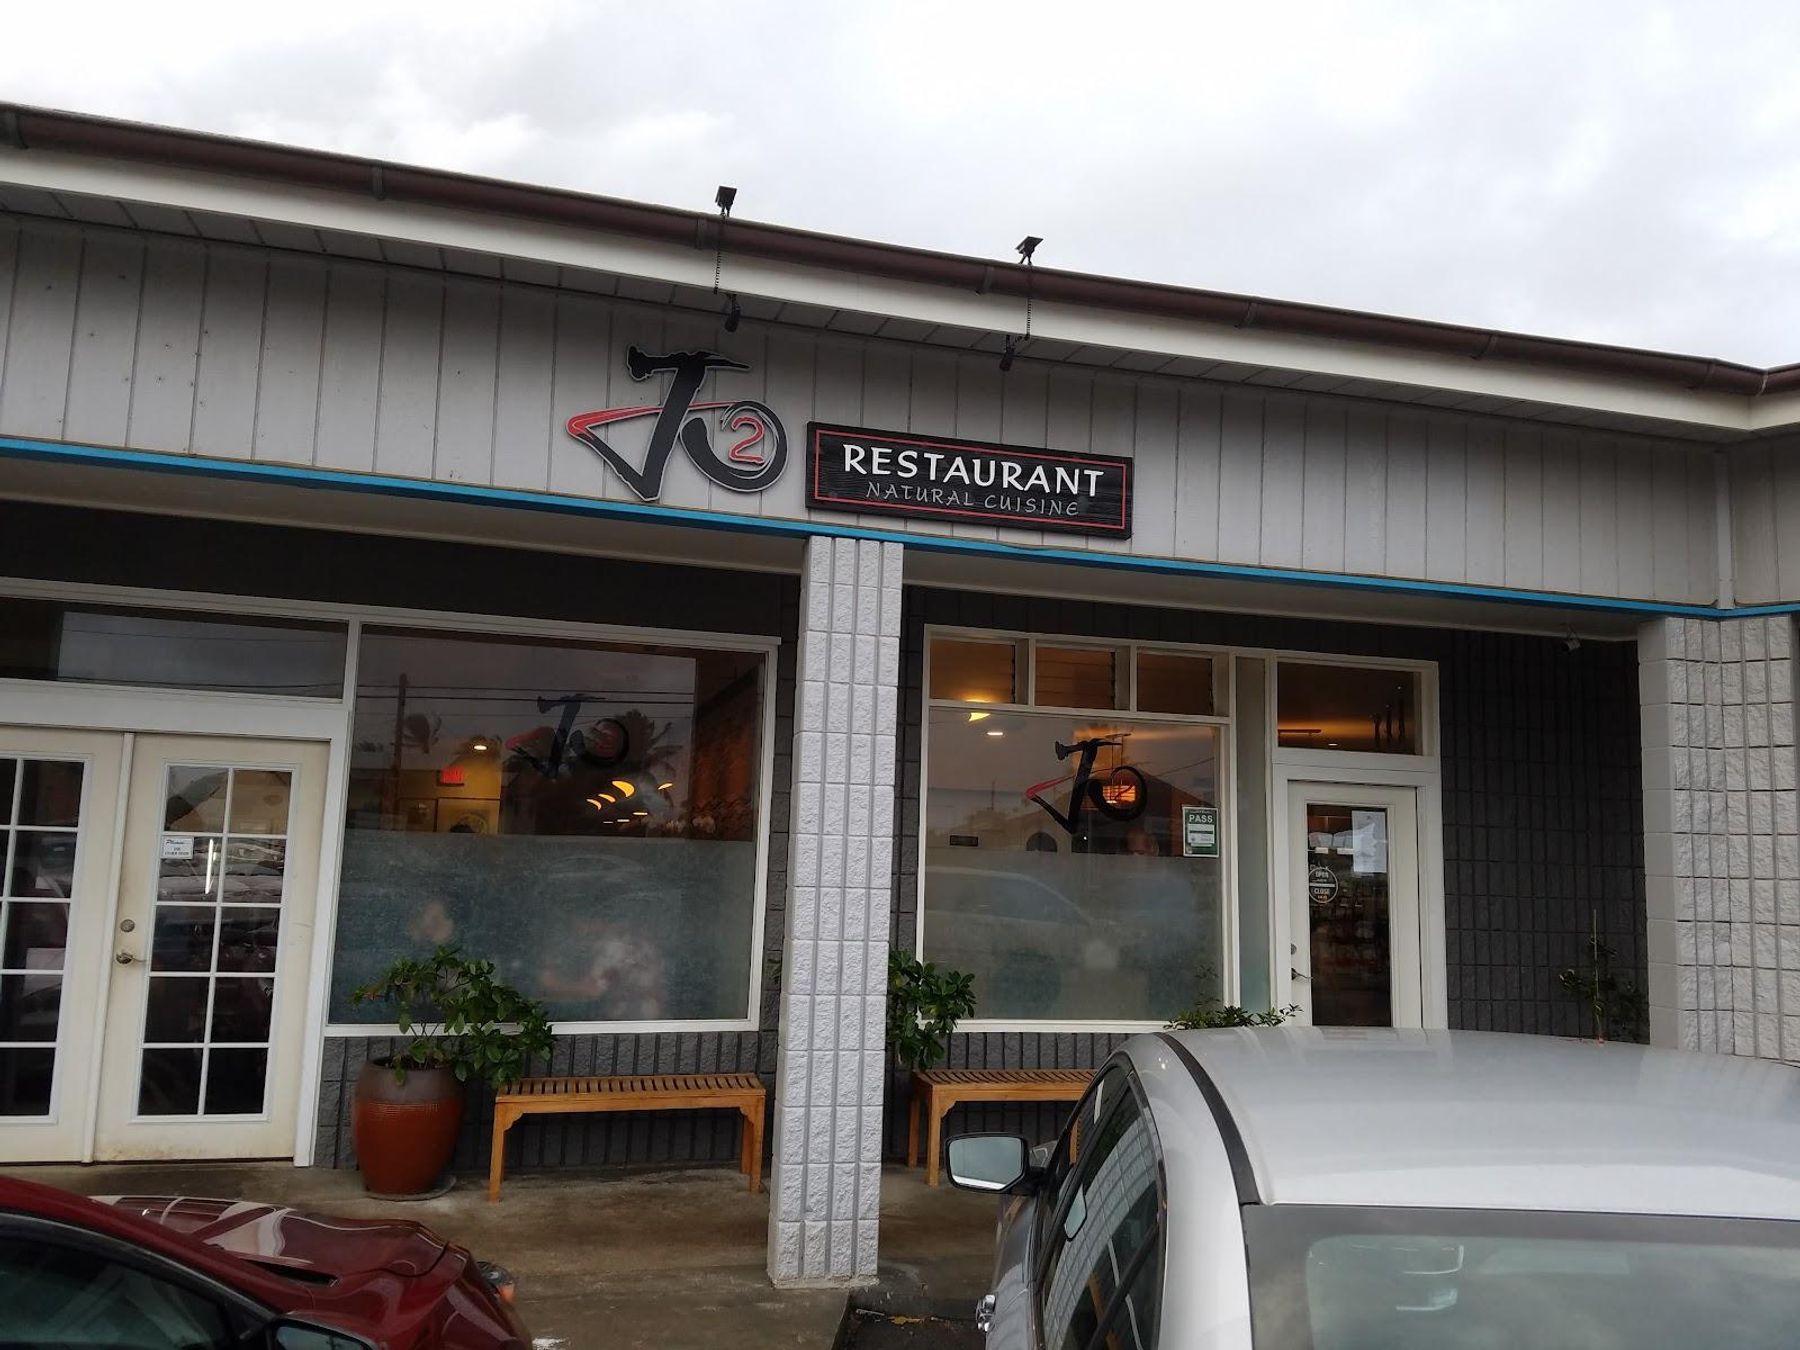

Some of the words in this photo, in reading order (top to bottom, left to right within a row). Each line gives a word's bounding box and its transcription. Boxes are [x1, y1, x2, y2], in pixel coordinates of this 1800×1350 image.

[842, 443, 1105, 498] RESTAURANT
[866, 481, 974, 506] NATURAL
[984, 494, 1079, 516] CUISINE
[1189, 814, 1213, 824] PASS
